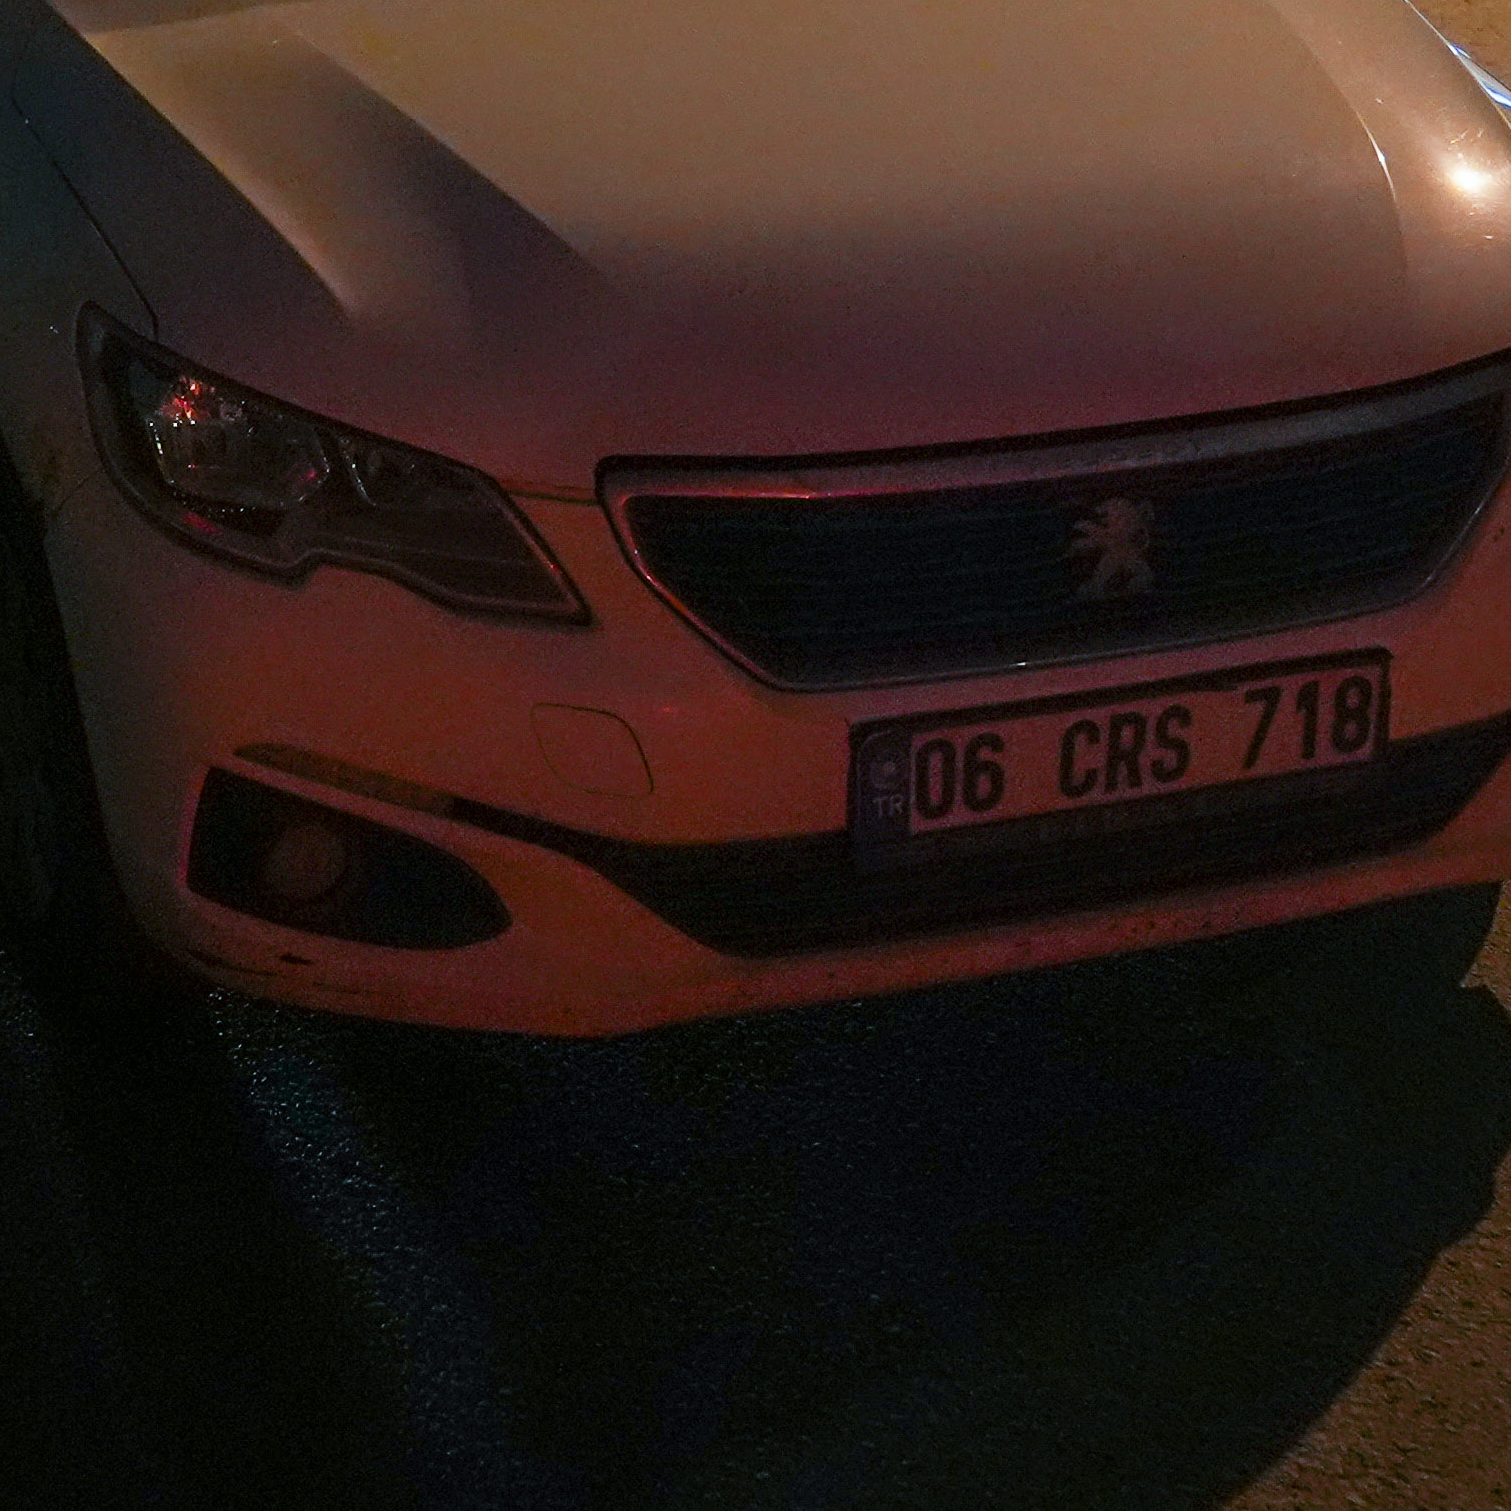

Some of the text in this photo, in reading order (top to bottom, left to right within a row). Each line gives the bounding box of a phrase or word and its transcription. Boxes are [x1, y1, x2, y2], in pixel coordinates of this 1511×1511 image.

[913, 675, 1374, 820] 06 CRS 718
[873, 792, 904, 820] TR
